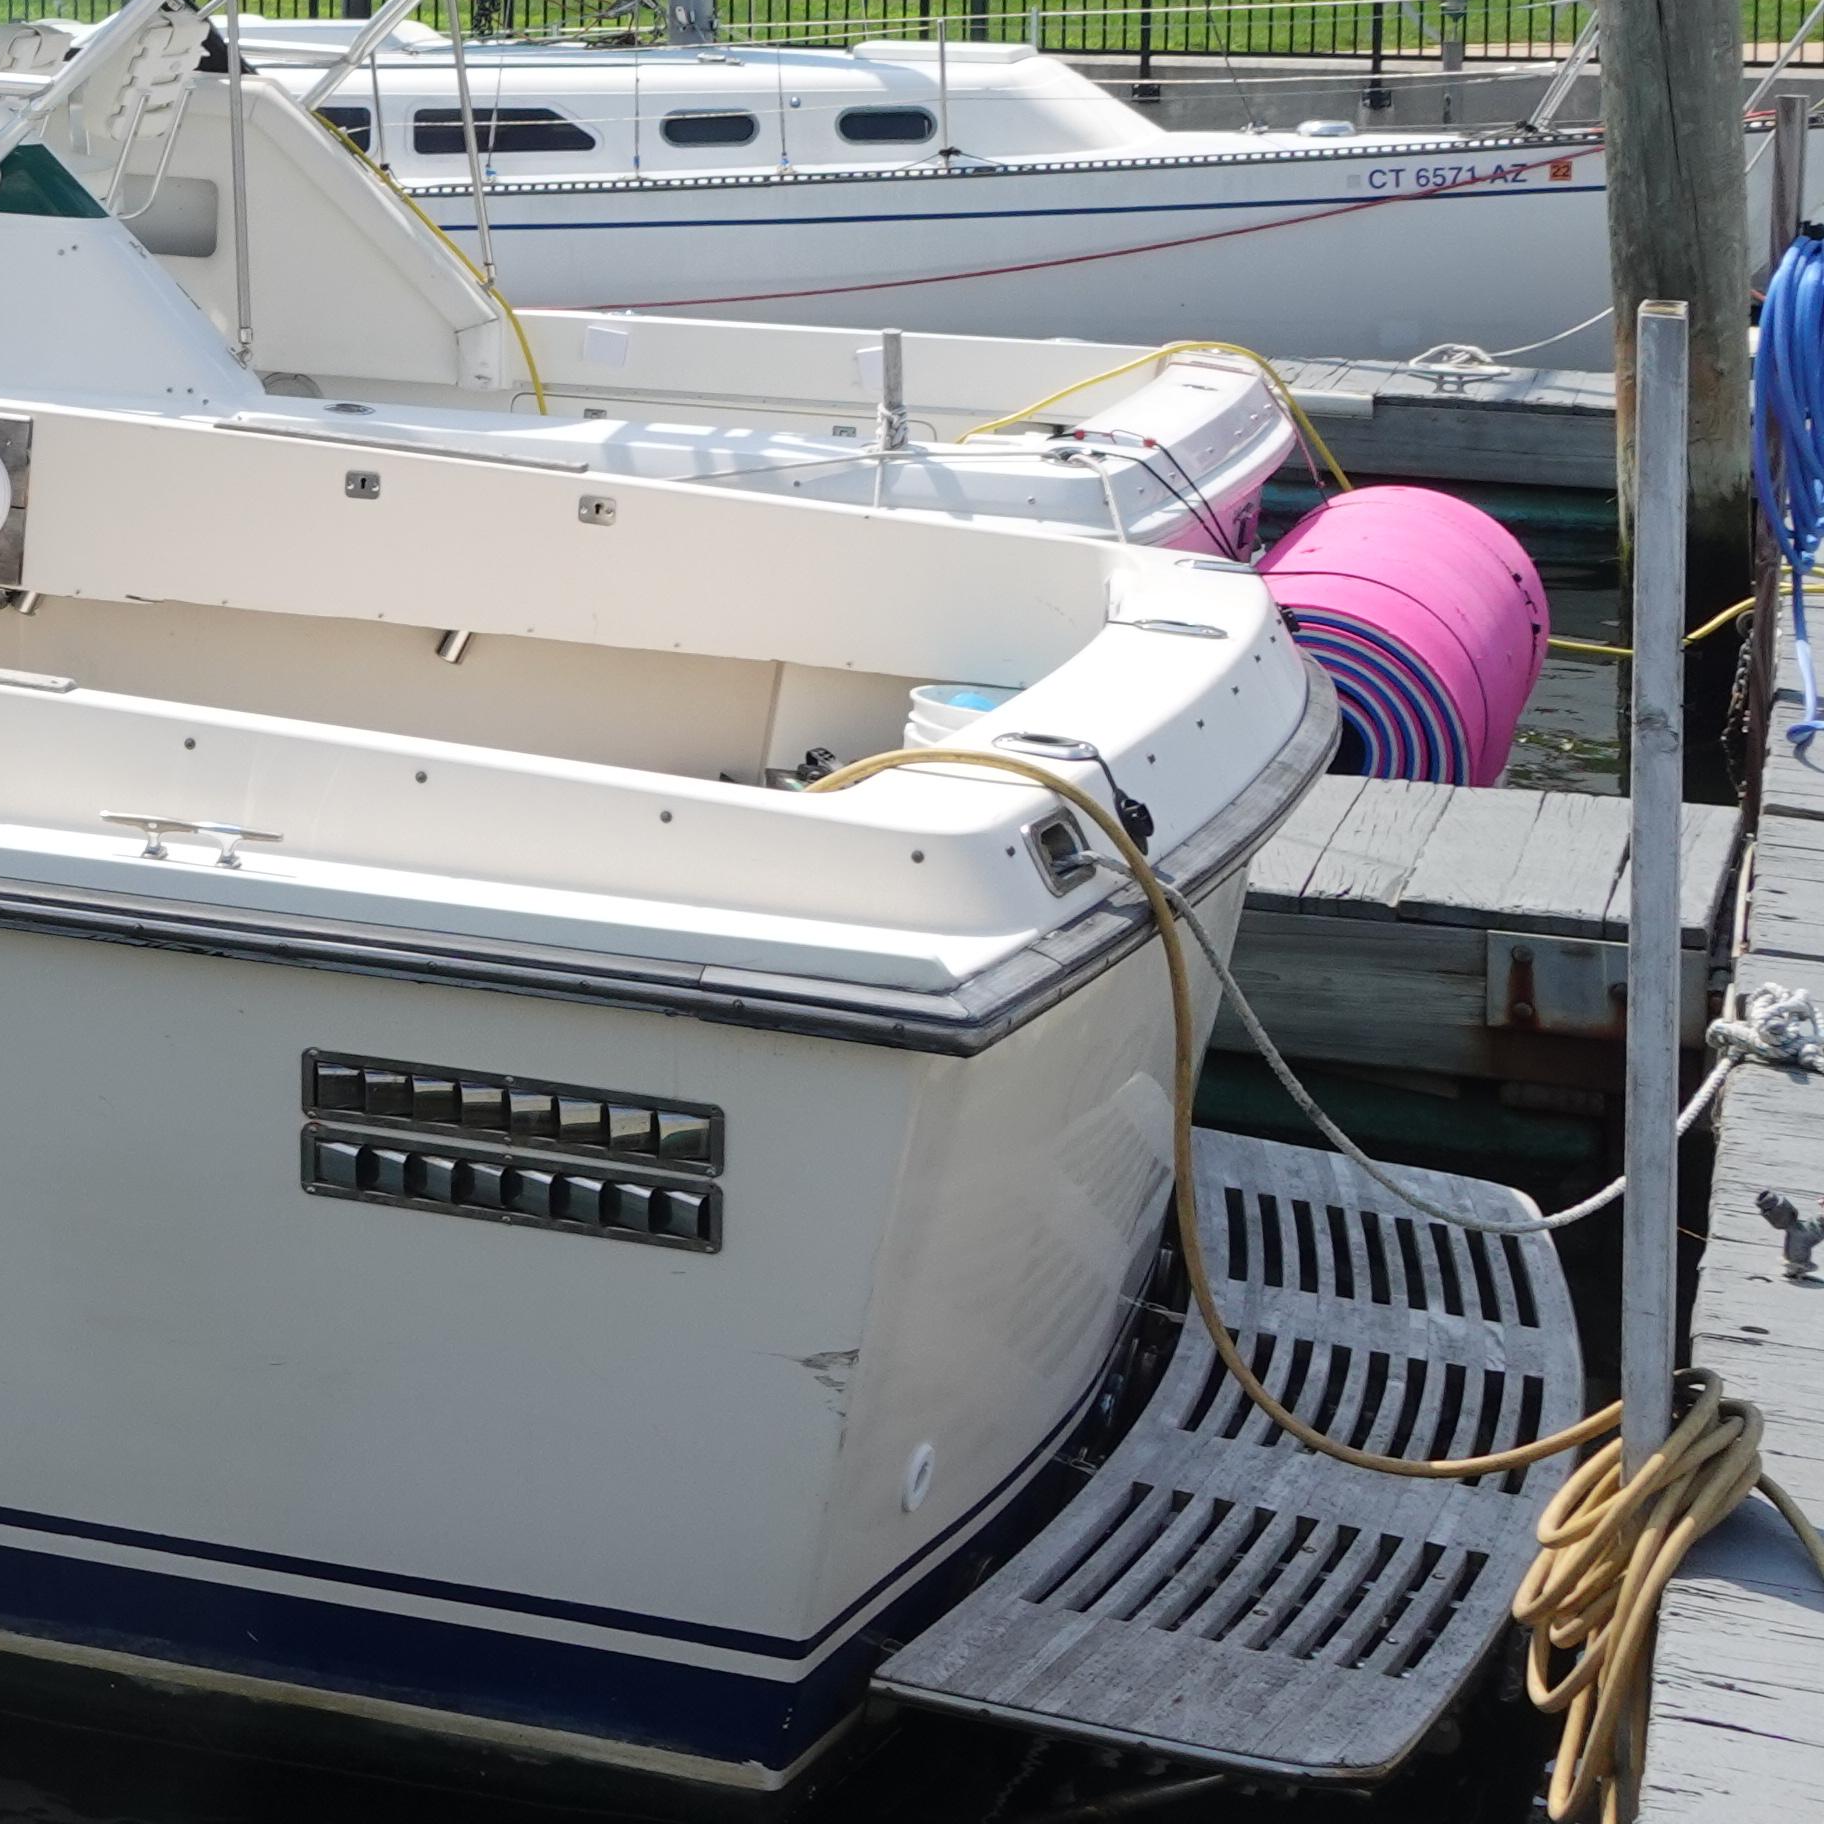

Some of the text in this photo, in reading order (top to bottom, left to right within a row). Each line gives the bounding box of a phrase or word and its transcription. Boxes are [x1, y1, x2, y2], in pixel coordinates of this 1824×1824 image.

[1368, 163, 1528, 189] CT 6571 AZ
[1551, 164, 1571, 177] 22
